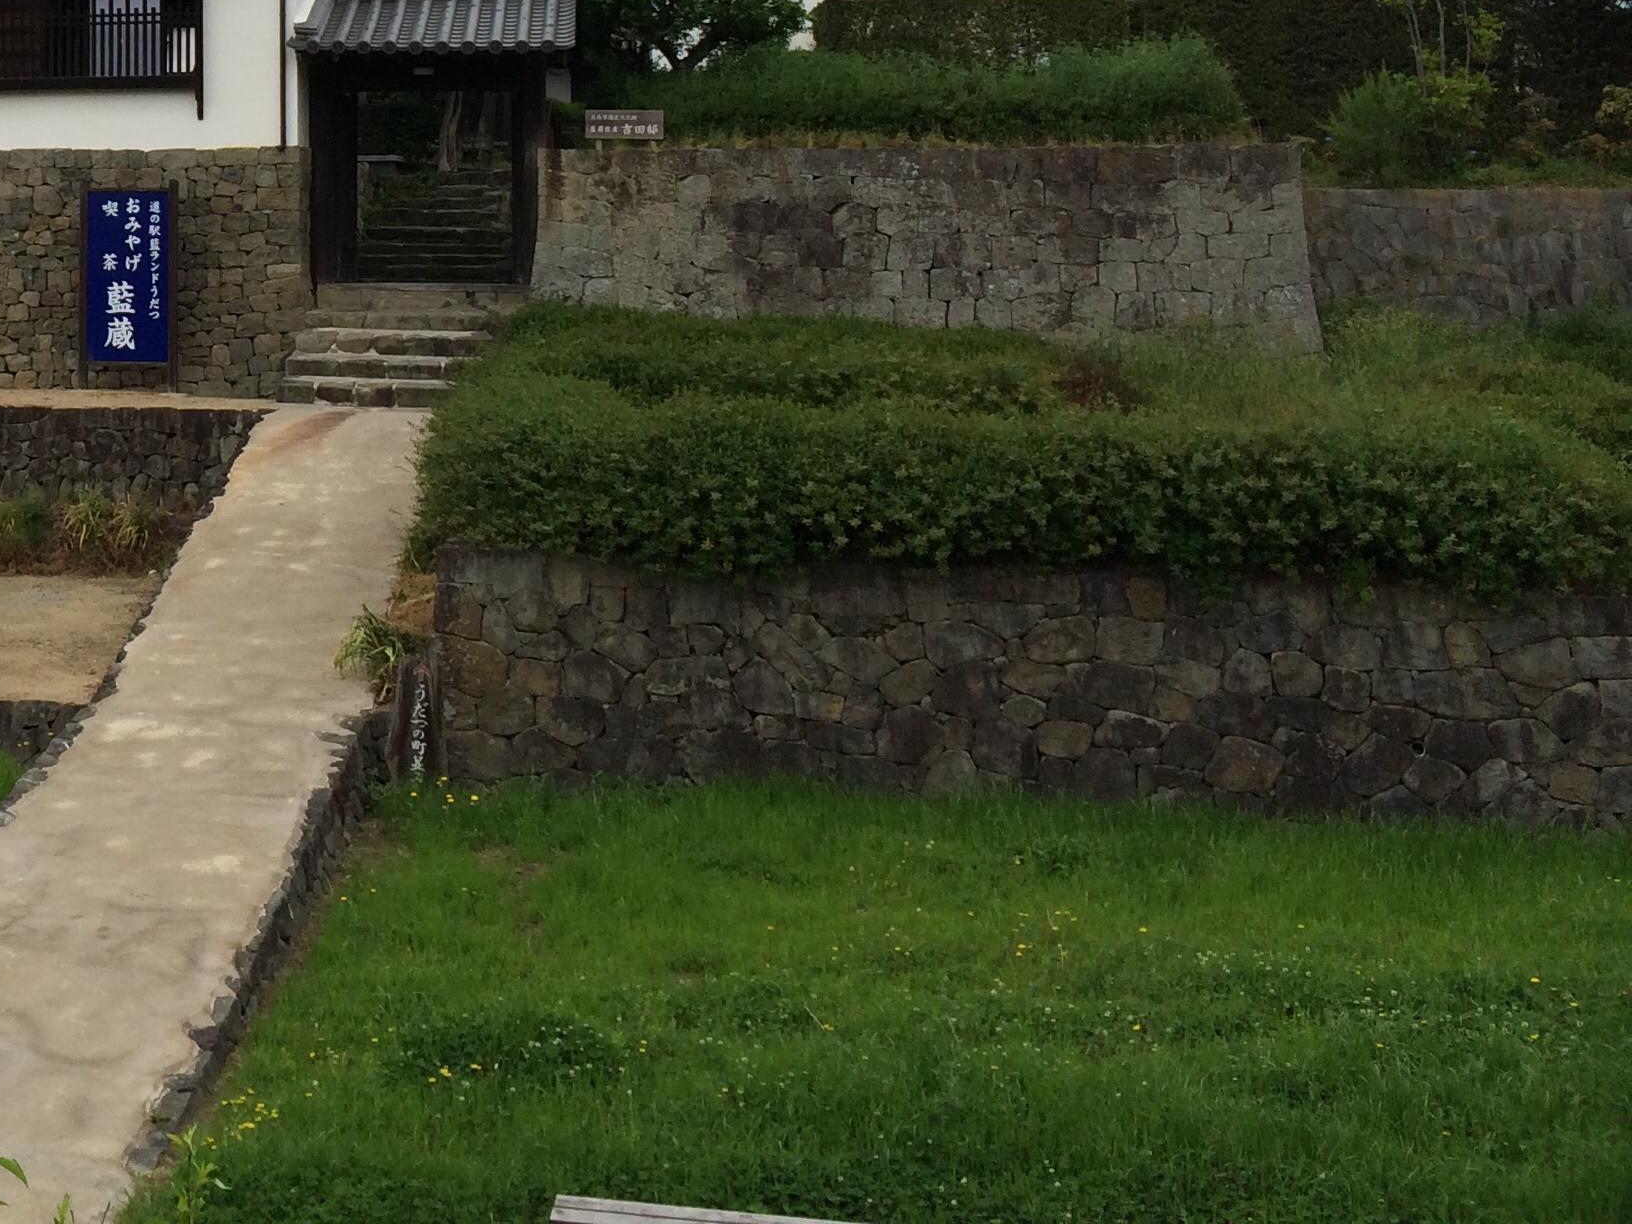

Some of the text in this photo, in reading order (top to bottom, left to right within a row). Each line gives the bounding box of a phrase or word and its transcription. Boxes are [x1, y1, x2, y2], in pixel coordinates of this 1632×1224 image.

[124, 197, 142, 272] おみやげ
[104, 280, 136, 350] 藍蔵
